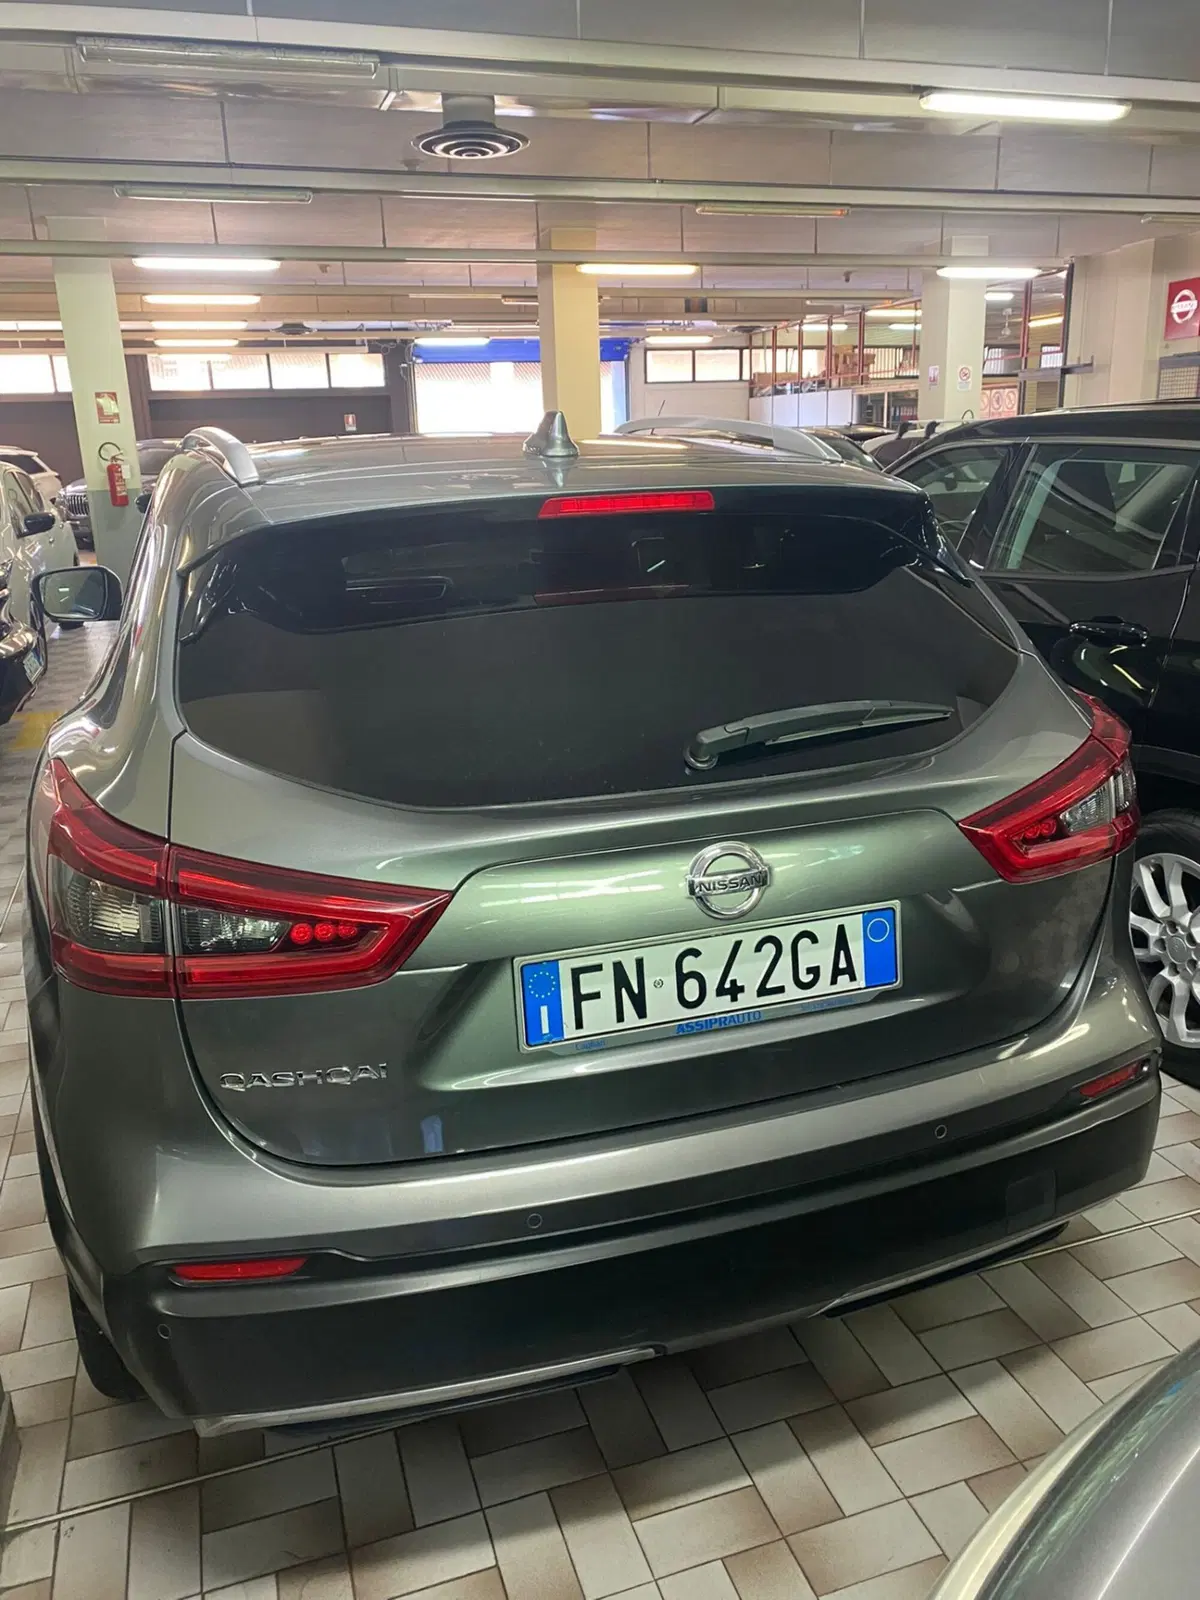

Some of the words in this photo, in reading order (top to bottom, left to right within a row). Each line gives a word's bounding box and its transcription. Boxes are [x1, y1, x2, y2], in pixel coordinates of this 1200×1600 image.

[699, 875, 761, 892] NISSAN
[570, 956, 648, 1031] FN
[675, 923, 858, 1010] 642GA
[676, 1010, 762, 1034] ASSIPRAUTO
[219, 1062, 387, 1092] QASHQAI
